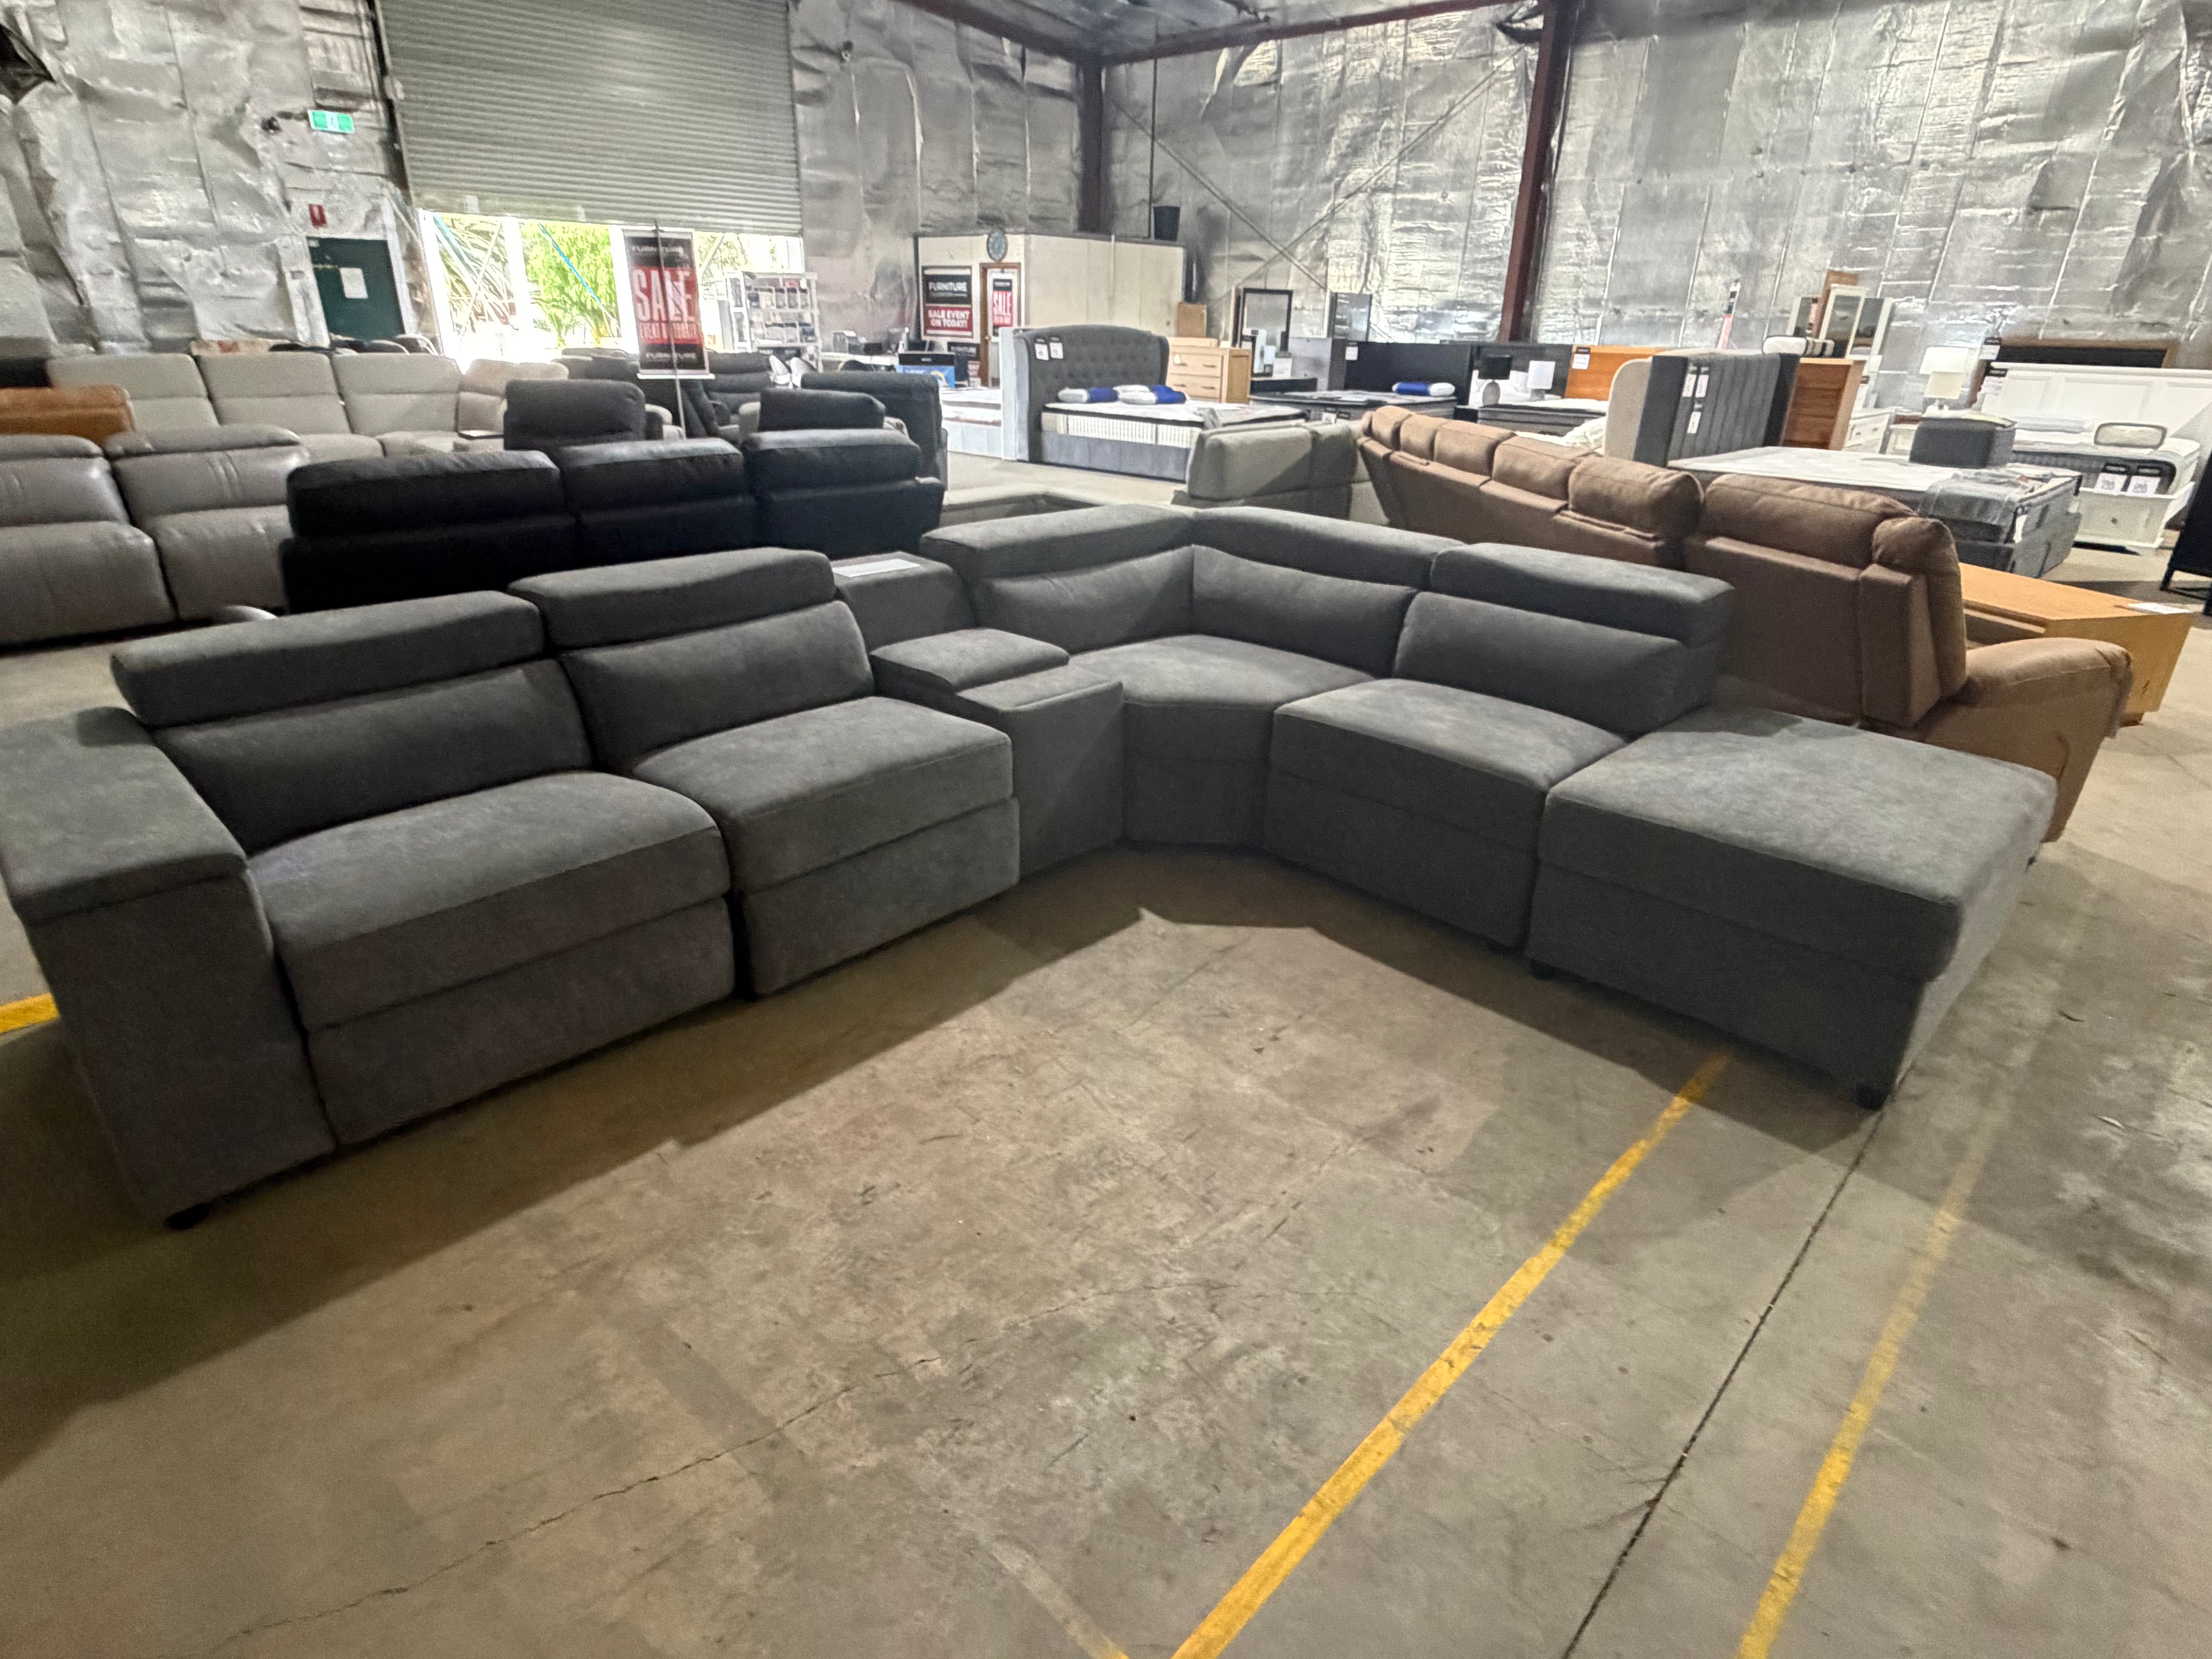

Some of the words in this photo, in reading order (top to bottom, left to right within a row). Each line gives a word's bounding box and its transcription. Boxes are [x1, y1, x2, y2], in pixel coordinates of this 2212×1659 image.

[632, 269, 696, 322] SALE
[929, 282, 967, 292] FURNITURE
[993, 292, 1012, 316] SALE
[928, 310, 945, 318] SALE
[946, 310, 970, 319] EVENT
